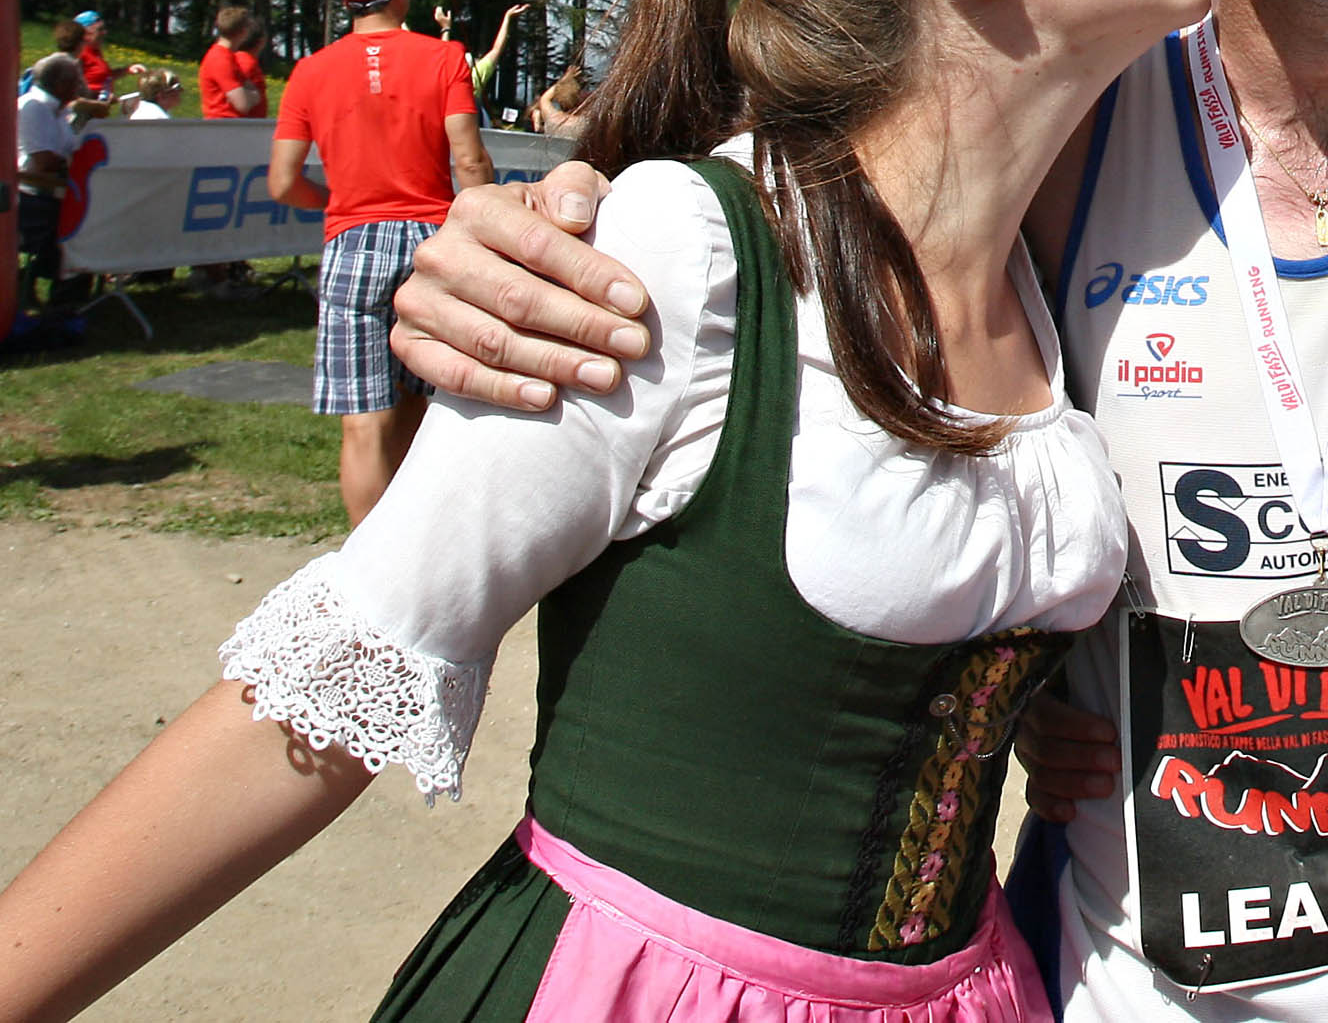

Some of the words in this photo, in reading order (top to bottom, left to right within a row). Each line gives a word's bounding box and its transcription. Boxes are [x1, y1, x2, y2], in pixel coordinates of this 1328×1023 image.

[1121, 274, 1210, 306] asics
[1248, 265, 1275, 338] RUNNING
[1118, 359, 1130, 382] il
[1134, 361, 1203, 388] podio
[1141, 385, 1182, 400] Sport
[1181, 665, 1254, 729] VAL
